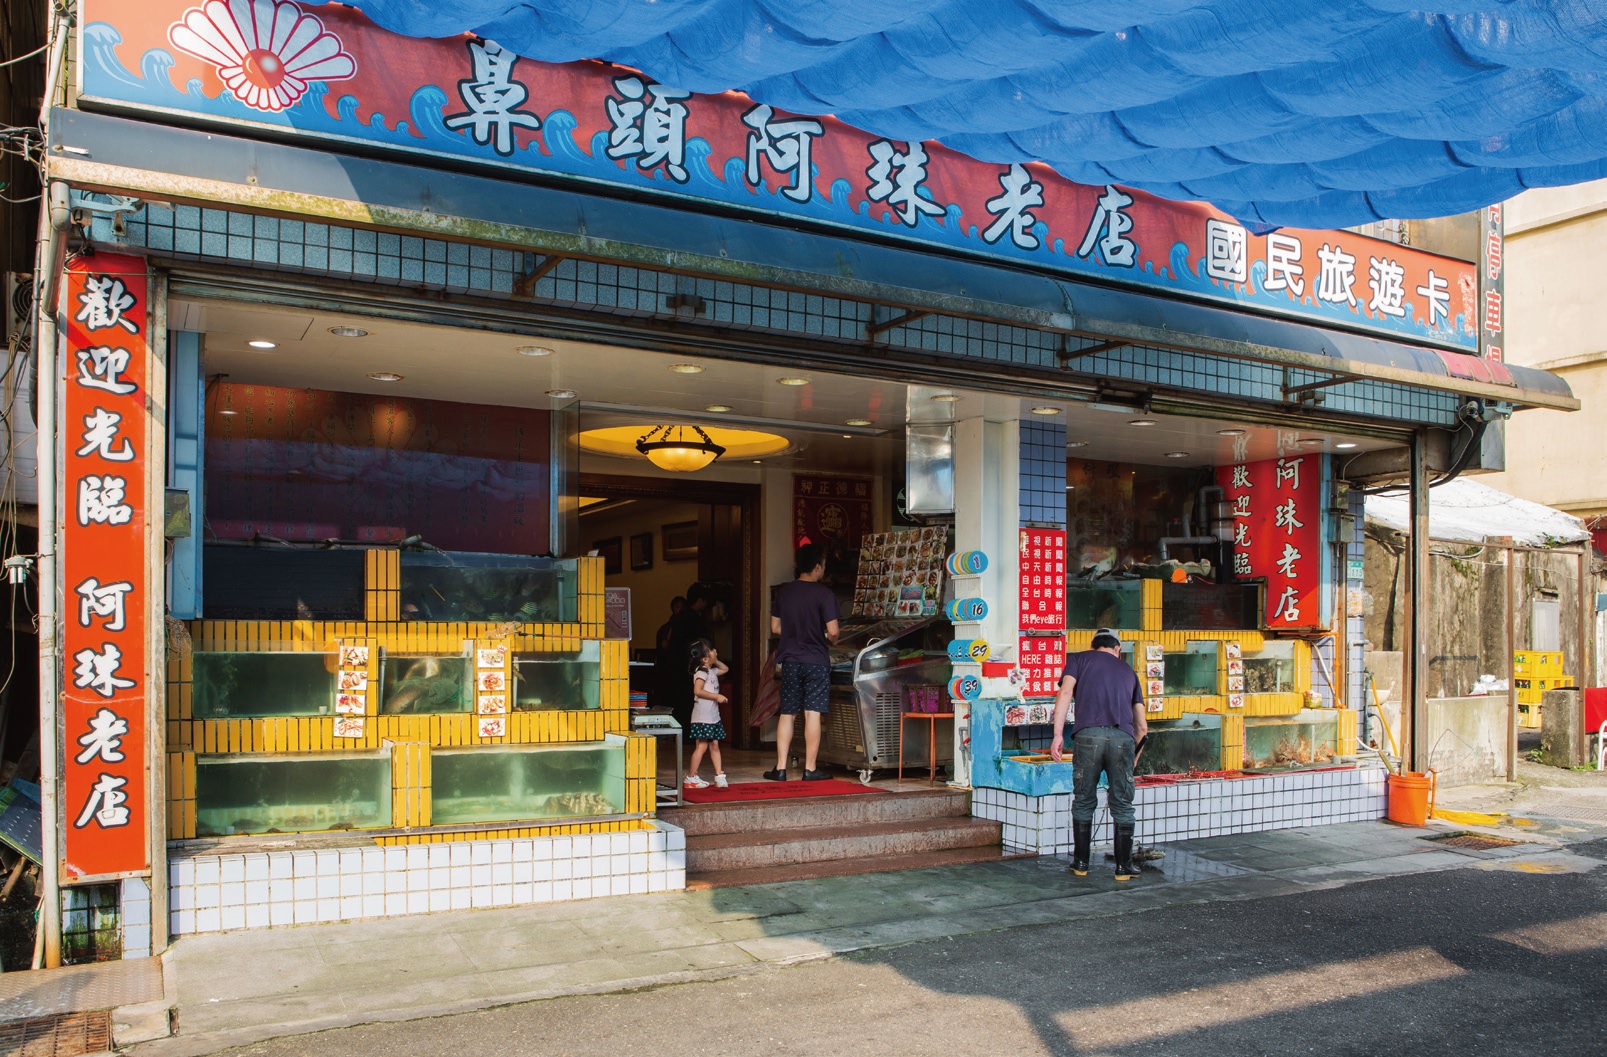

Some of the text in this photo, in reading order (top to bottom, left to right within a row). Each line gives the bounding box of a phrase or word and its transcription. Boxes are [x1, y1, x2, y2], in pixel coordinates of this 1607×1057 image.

[444, 39, 1138, 268] 鼻頭阿珠老店
[1206, 218, 1450, 324] 國民旅遊卡
[1231, 465, 1254, 575] 歡迎光臨
[1274, 457, 1304, 623] 阿珠老店
[72, 275, 139, 828] 歡迎光臨 阿珠老店
[1022, 561, 1063, 573] 中天新聞
[1022, 574, 1063, 586] 自由時報
[972, 603, 983, 615] 16
[1022, 600, 1062, 611] 聯合報
[971, 644, 987, 657] 29
[1022, 654, 1062, 664] HERE 雜誌
[964, 679, 978, 692] 39
